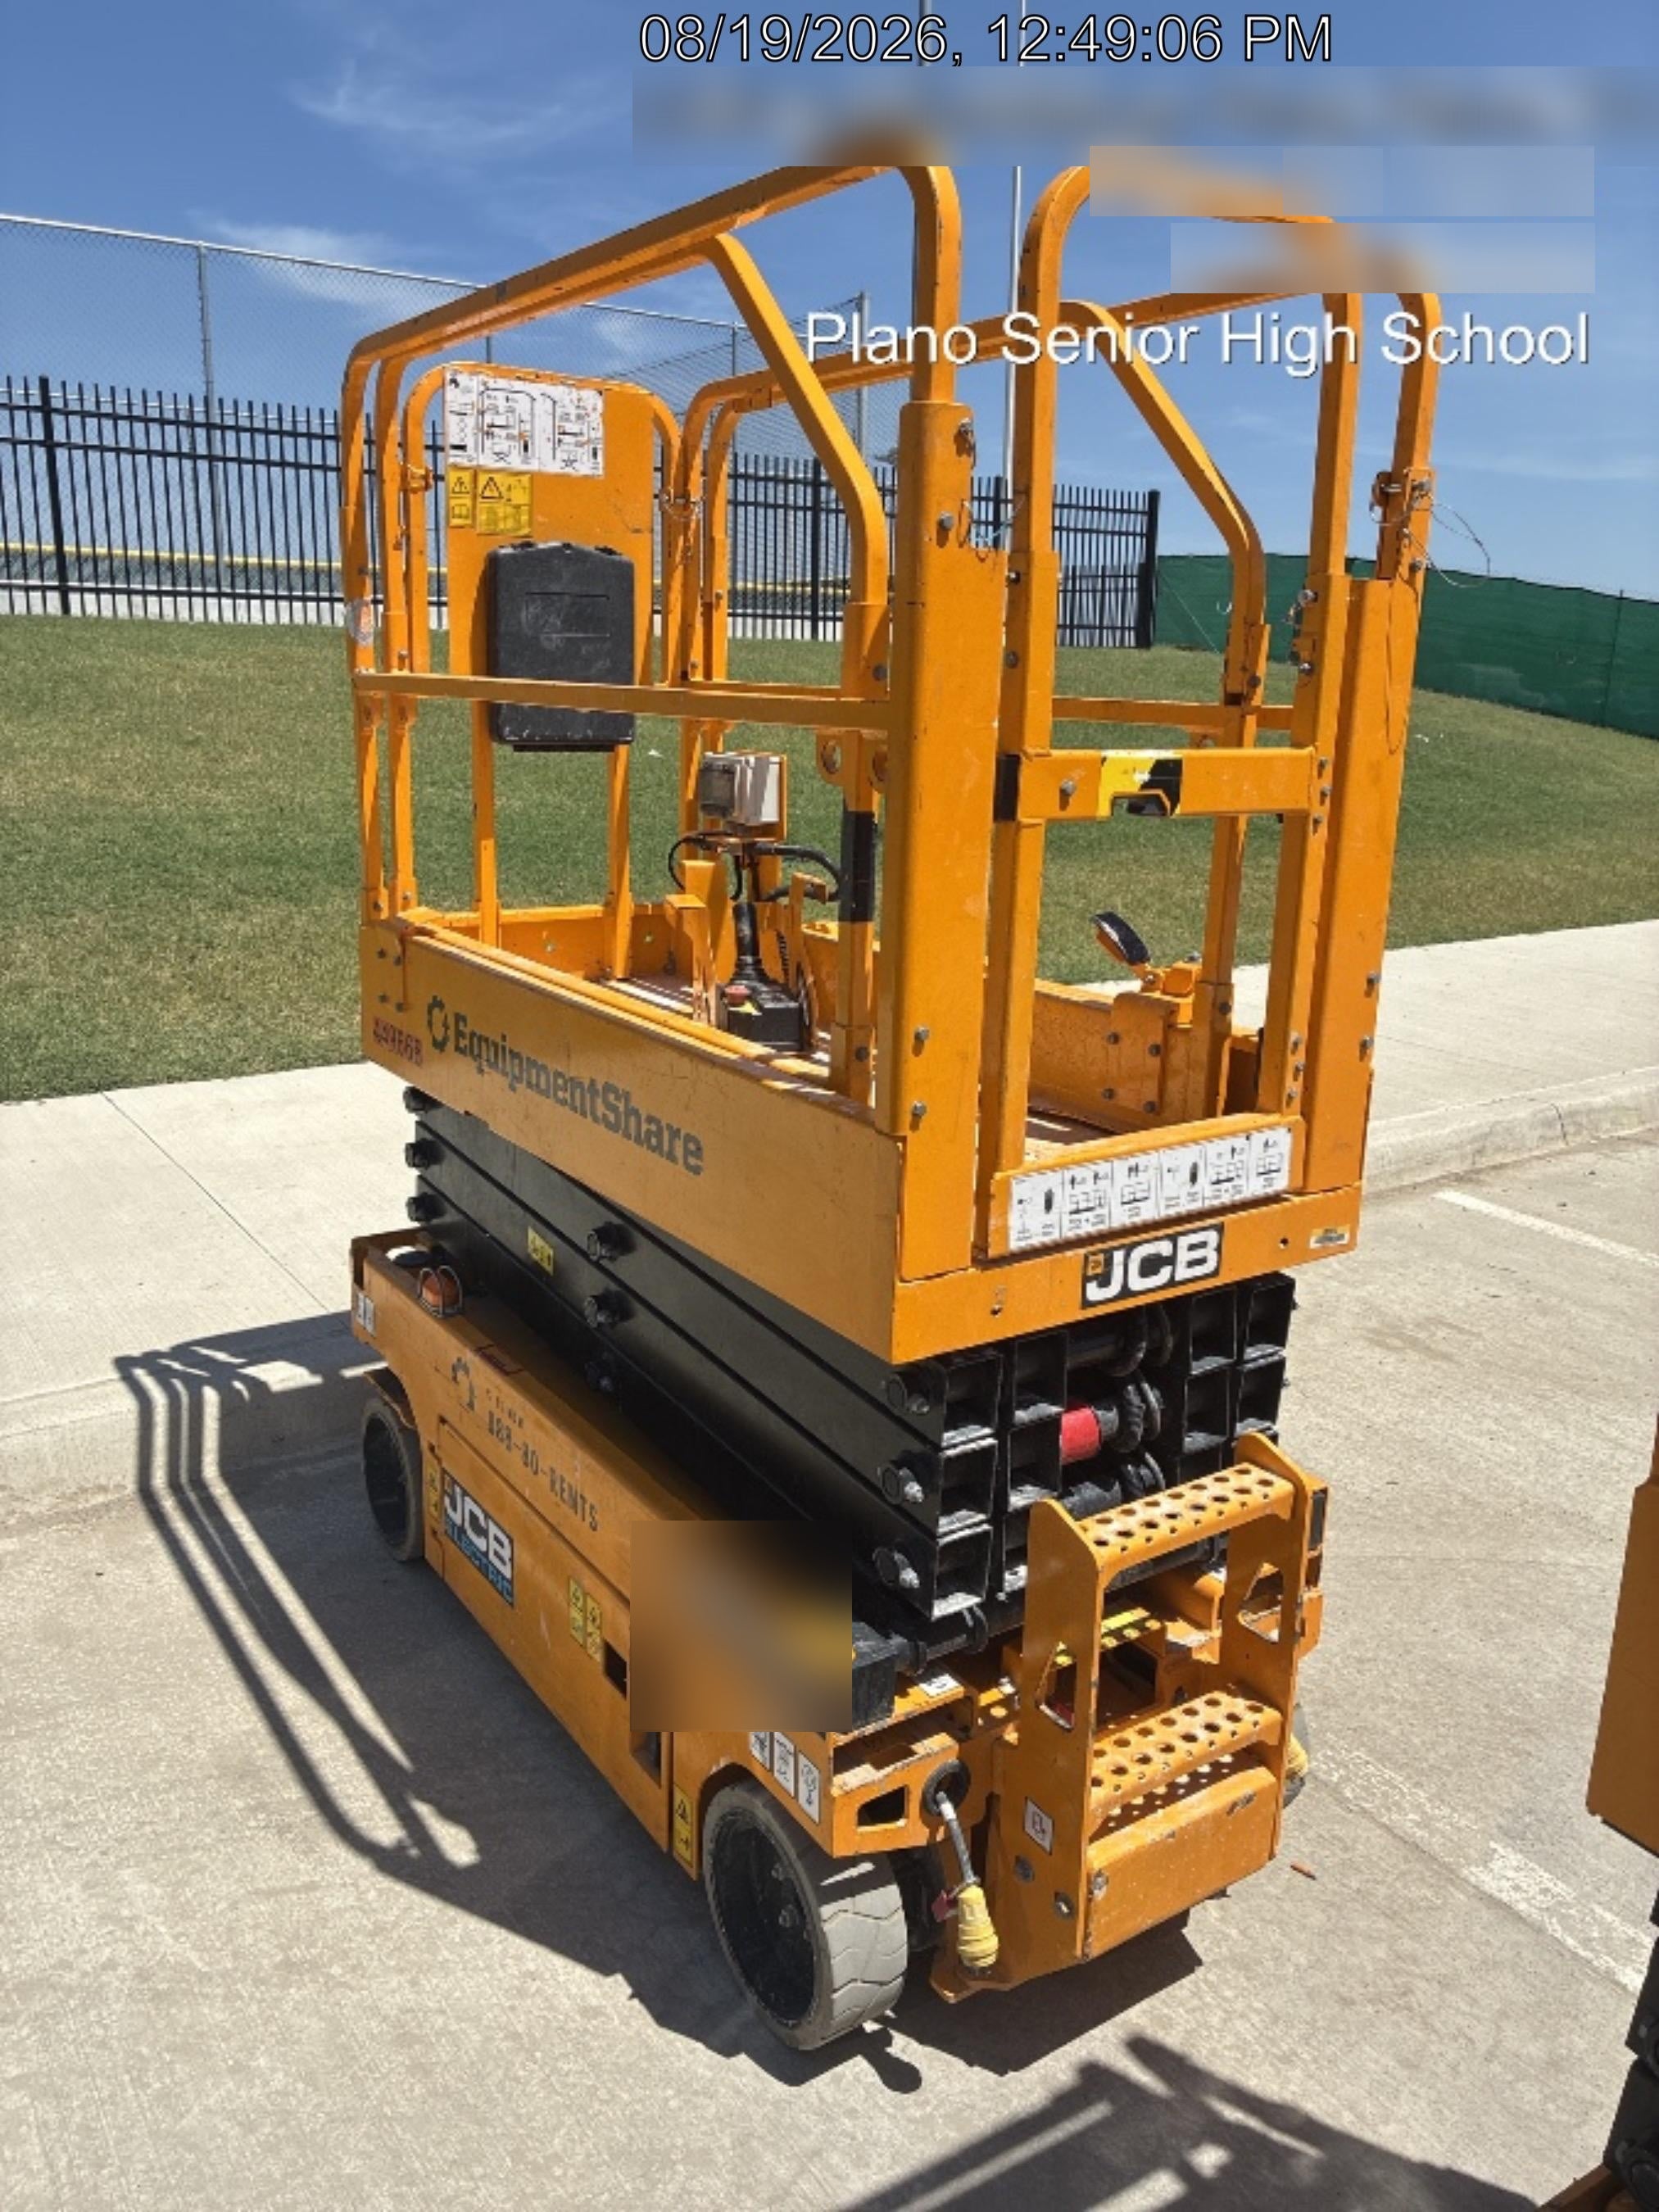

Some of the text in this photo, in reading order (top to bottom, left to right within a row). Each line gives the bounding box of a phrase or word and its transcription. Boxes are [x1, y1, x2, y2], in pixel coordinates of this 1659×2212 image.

[453, 1011, 705, 1176] EquipmentShare
[1086, 1229, 1220, 1302] JCB
[444, 1481, 513, 1583] JCB
